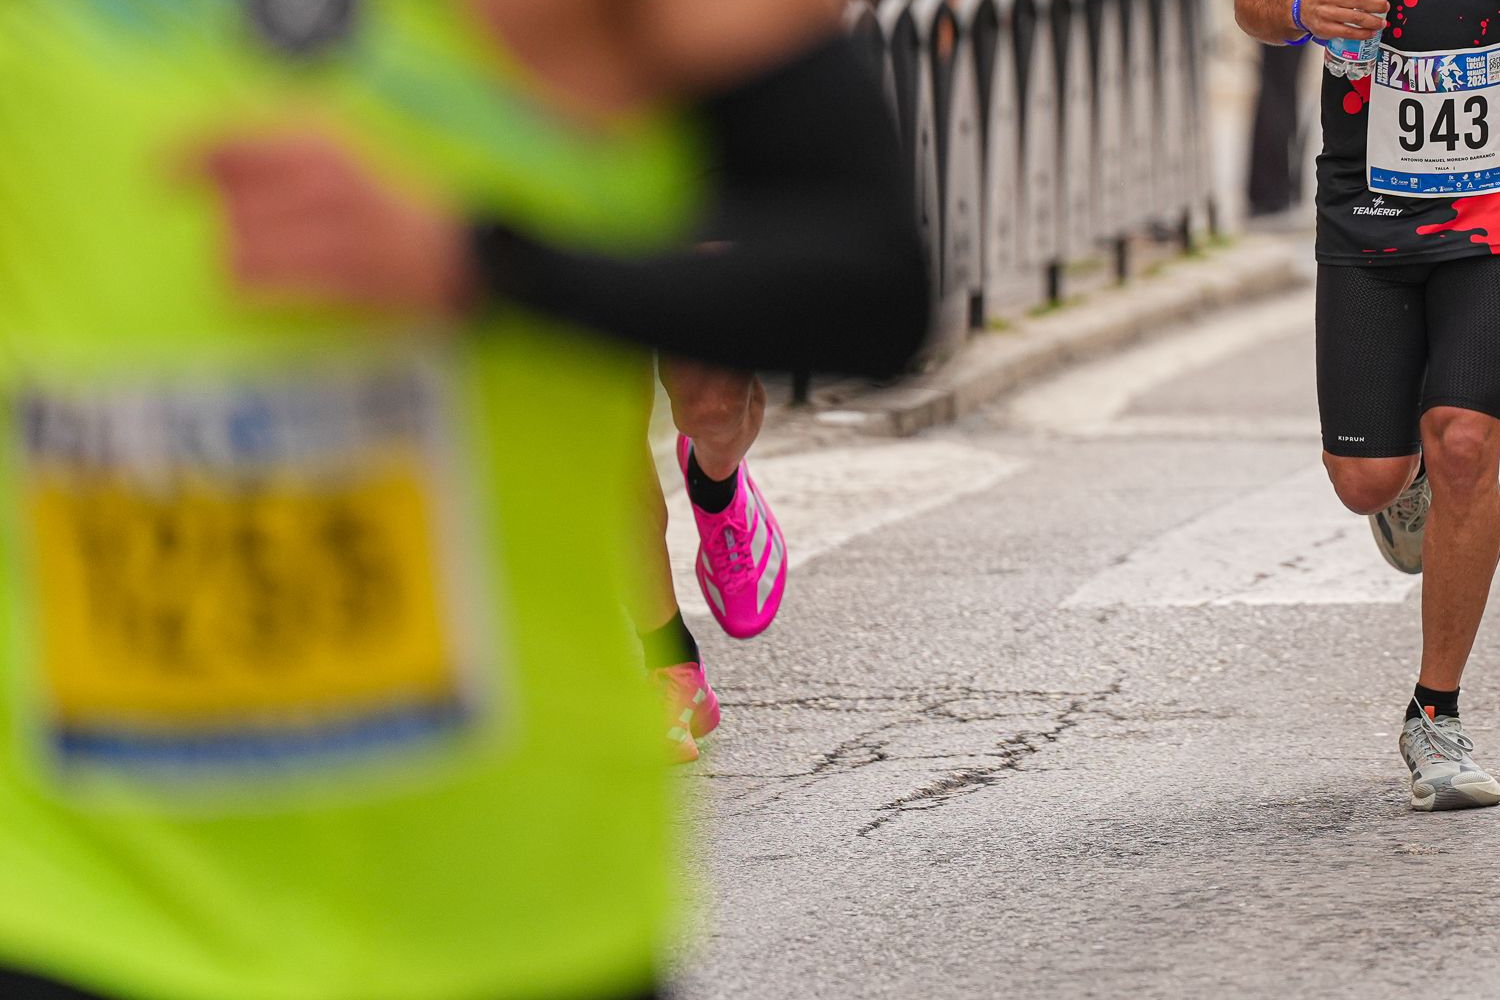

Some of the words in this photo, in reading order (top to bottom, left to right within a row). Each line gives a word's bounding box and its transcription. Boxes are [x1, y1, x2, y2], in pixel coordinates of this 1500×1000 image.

[1381, 51, 1390, 85] MARATÓN
[1390, 54, 1437, 91] 21K
[1466, 61, 1486, 69] LUCENA
[1467, 75, 1486, 87] 2026
[1398, 95, 1489, 152] 943
[1353, 207, 1403, 216] TEAMERGY
